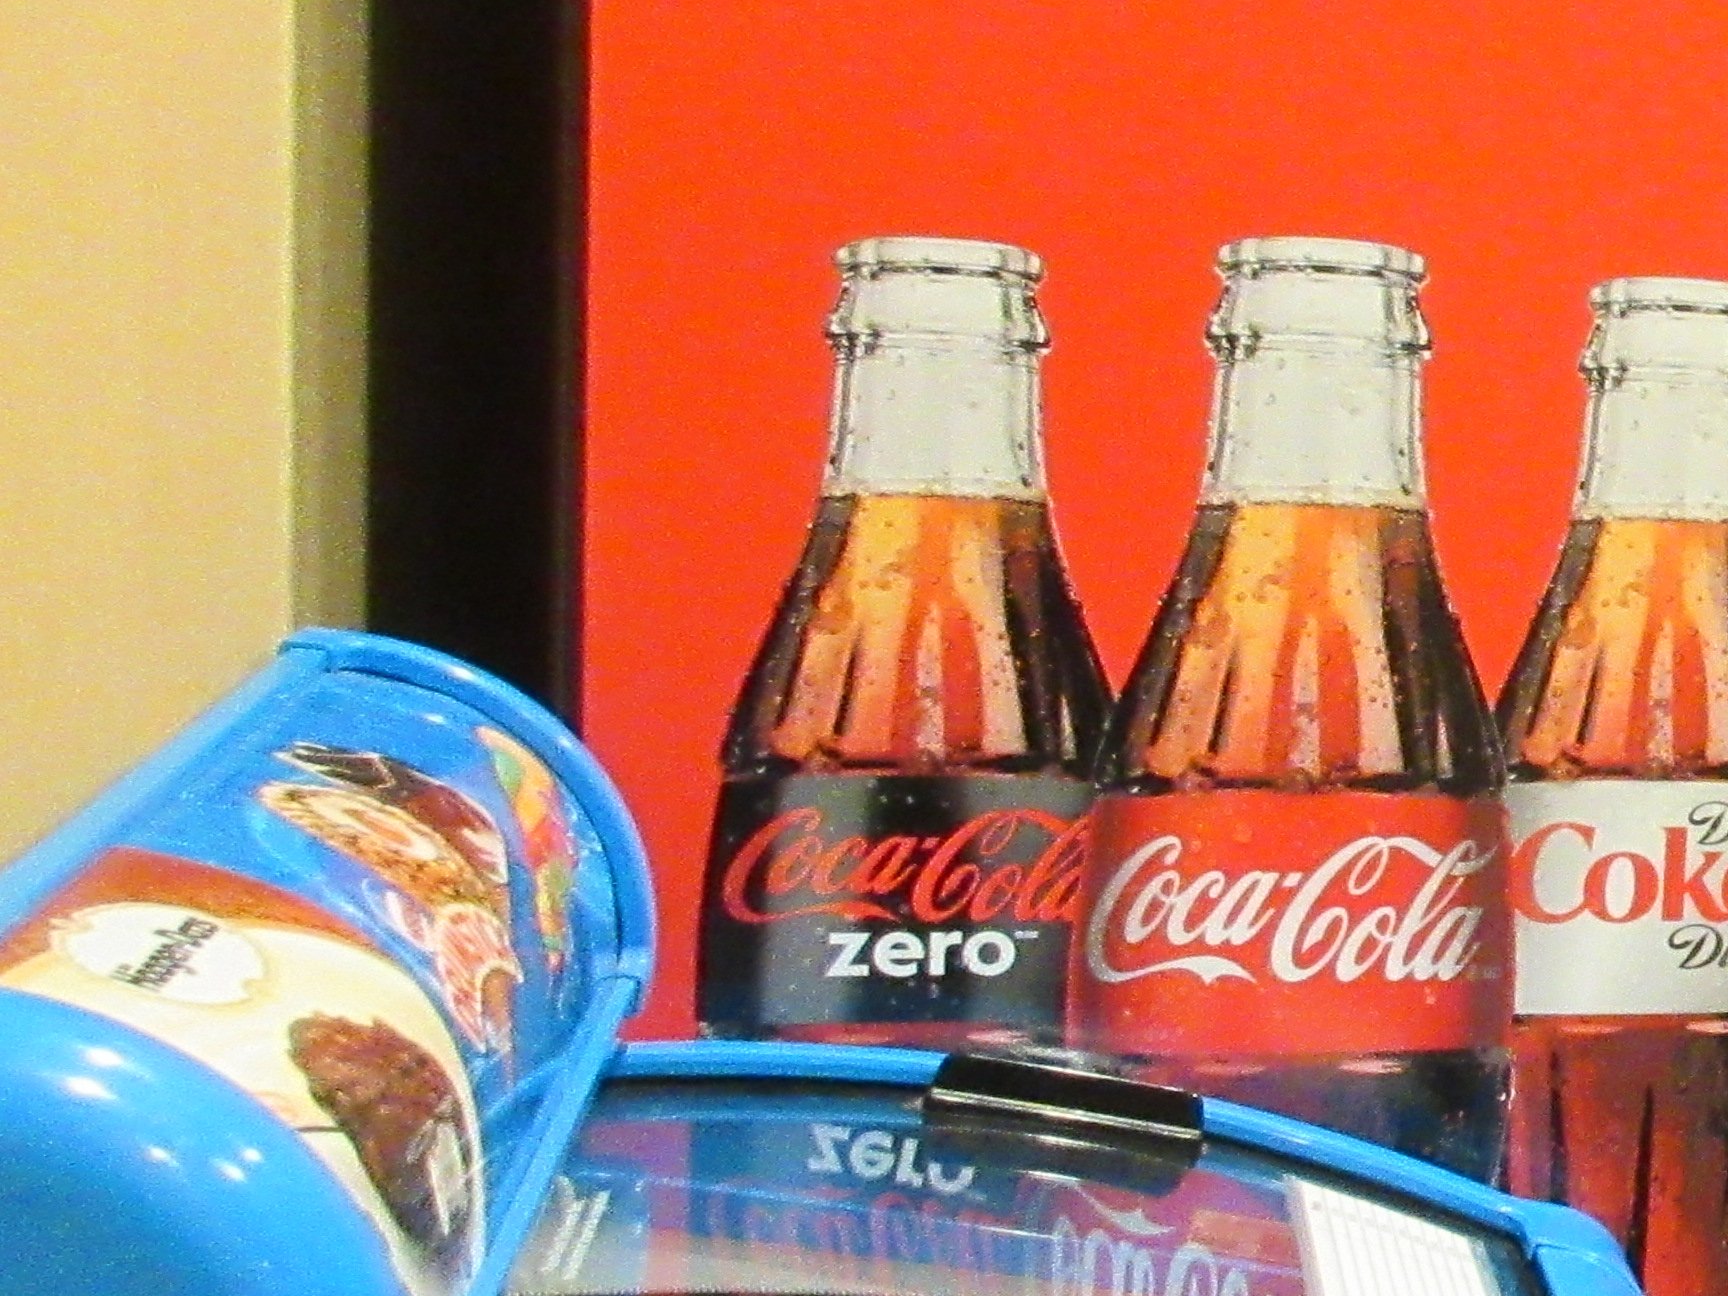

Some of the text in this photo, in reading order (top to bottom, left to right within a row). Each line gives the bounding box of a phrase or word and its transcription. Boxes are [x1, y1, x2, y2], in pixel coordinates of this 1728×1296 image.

[722, 807, 1089, 924] Coca-Cola
[1086, 835, 1498, 984] Coca-Cola
[825, 930, 1017, 978] zero
